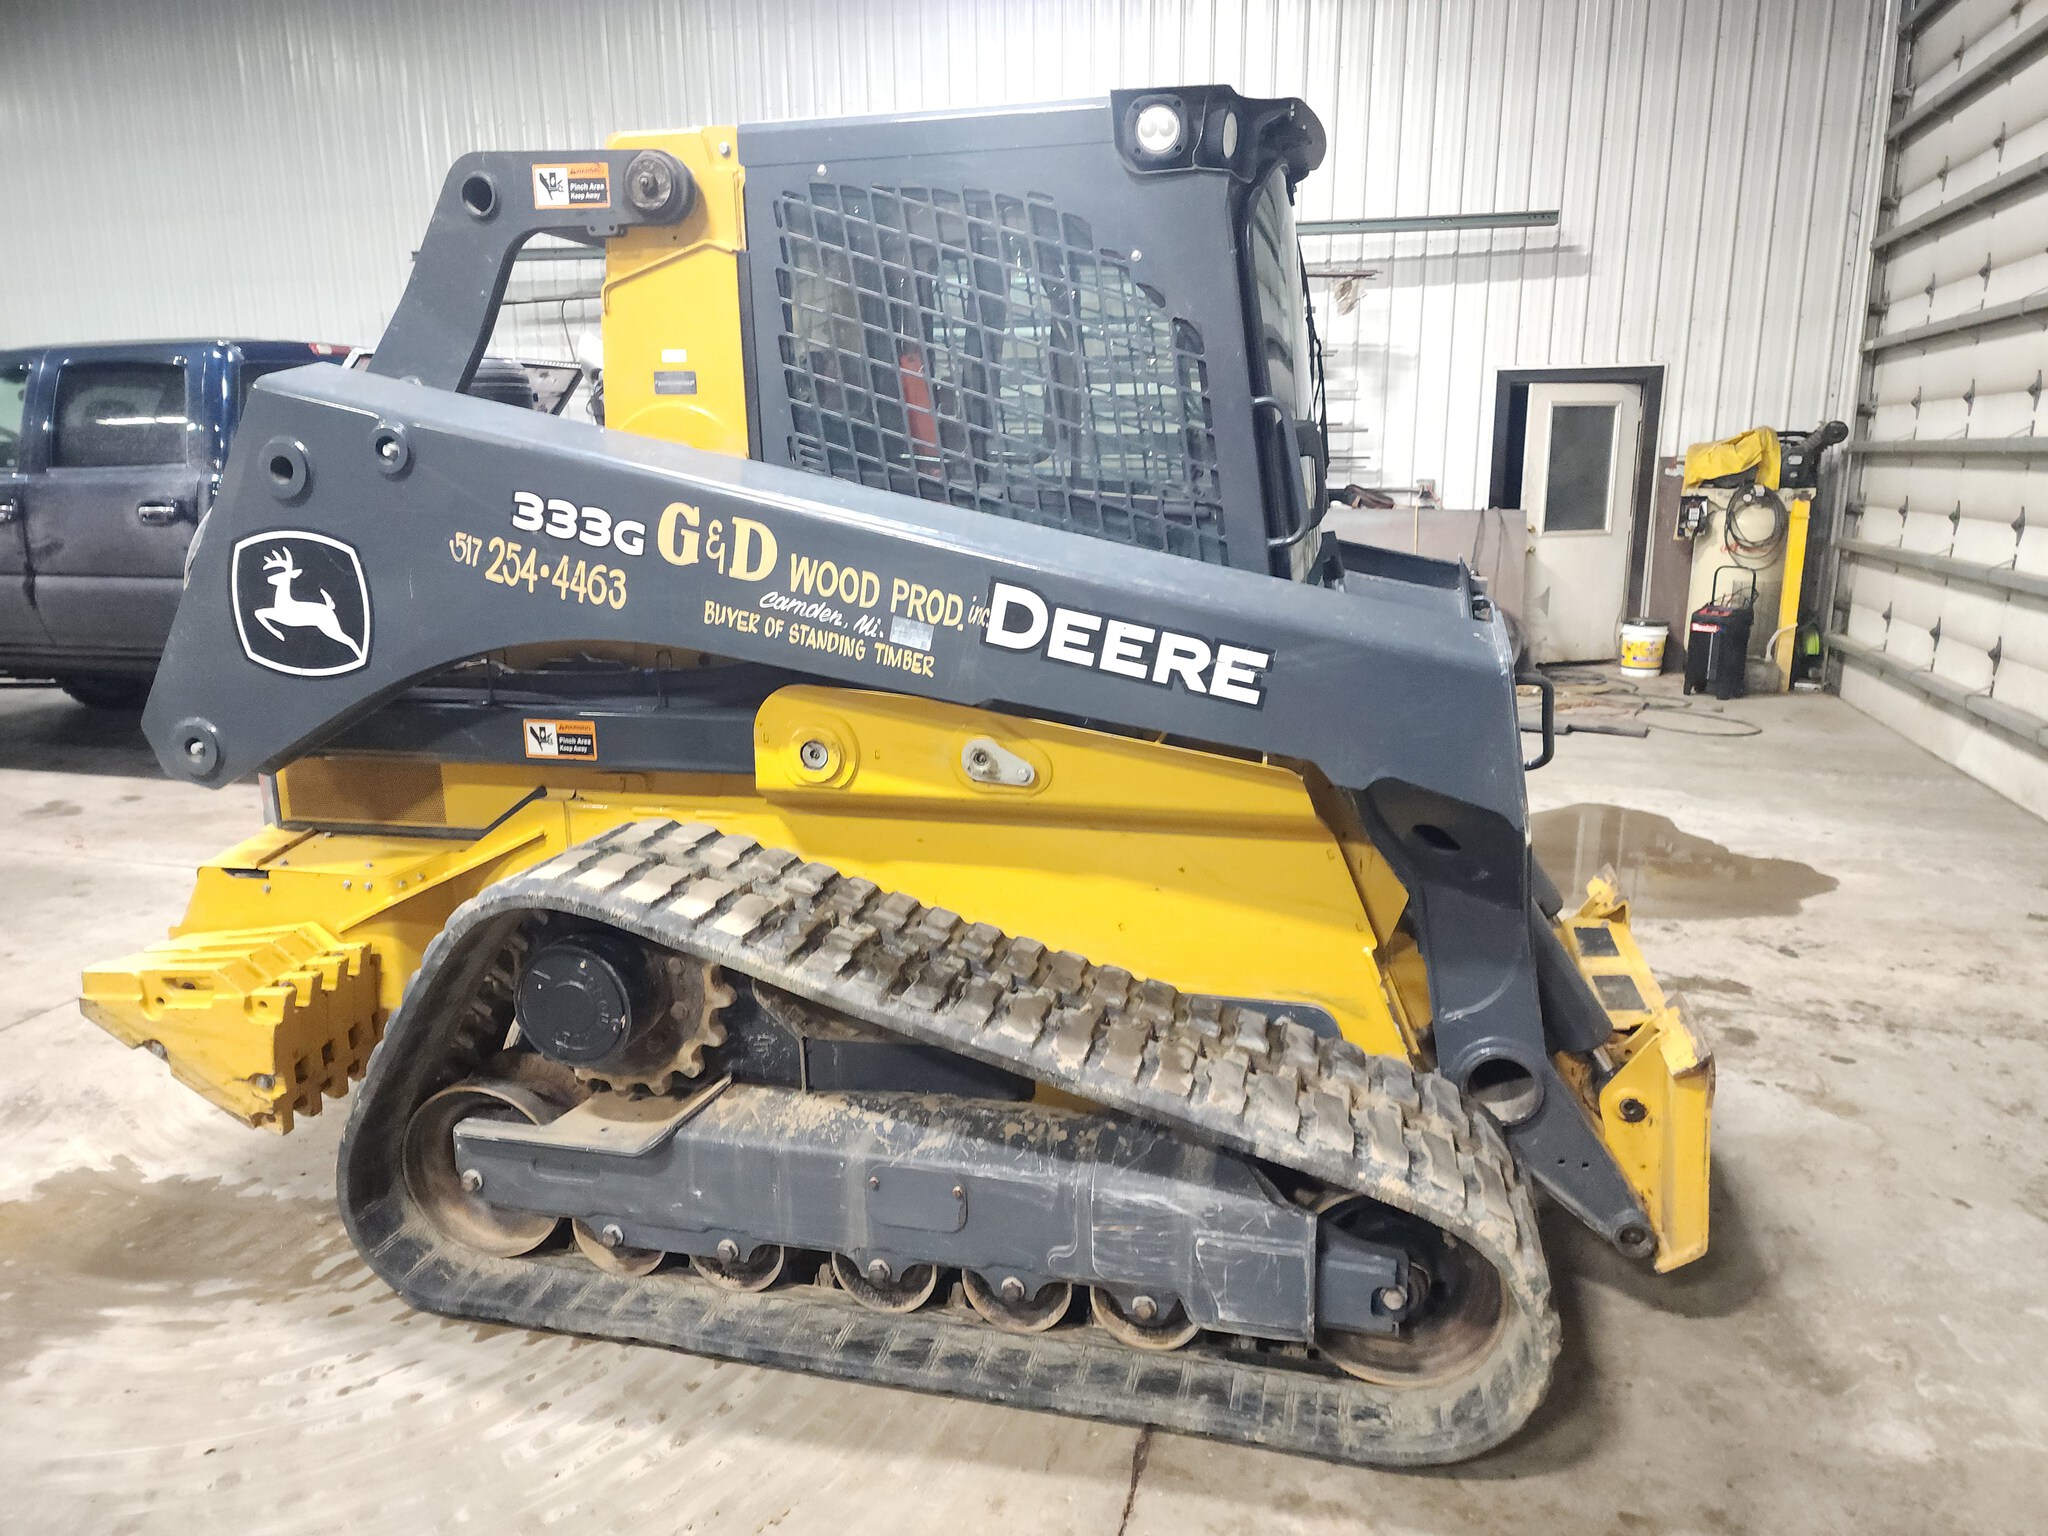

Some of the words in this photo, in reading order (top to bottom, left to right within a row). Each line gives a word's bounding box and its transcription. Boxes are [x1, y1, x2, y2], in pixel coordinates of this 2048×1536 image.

[585, 192, 600, 200] Away
[589, 182, 605, 191] Area
[512, 491, 646, 556] 333G
[449, 531, 483, 568] 517
[790, 553, 880, 609] WOOD
[890, 577, 964, 632] PROD.
[703, 600, 761, 635] BUYER
[764, 616, 785, 640] OF
[788, 622, 867, 661] STANDING
[874, 641, 936, 679] TIMBER
[853, 614, 884, 638] Mi.
[985, 582, 1270, 706] DEERE
[577, 737, 591, 745] Area
